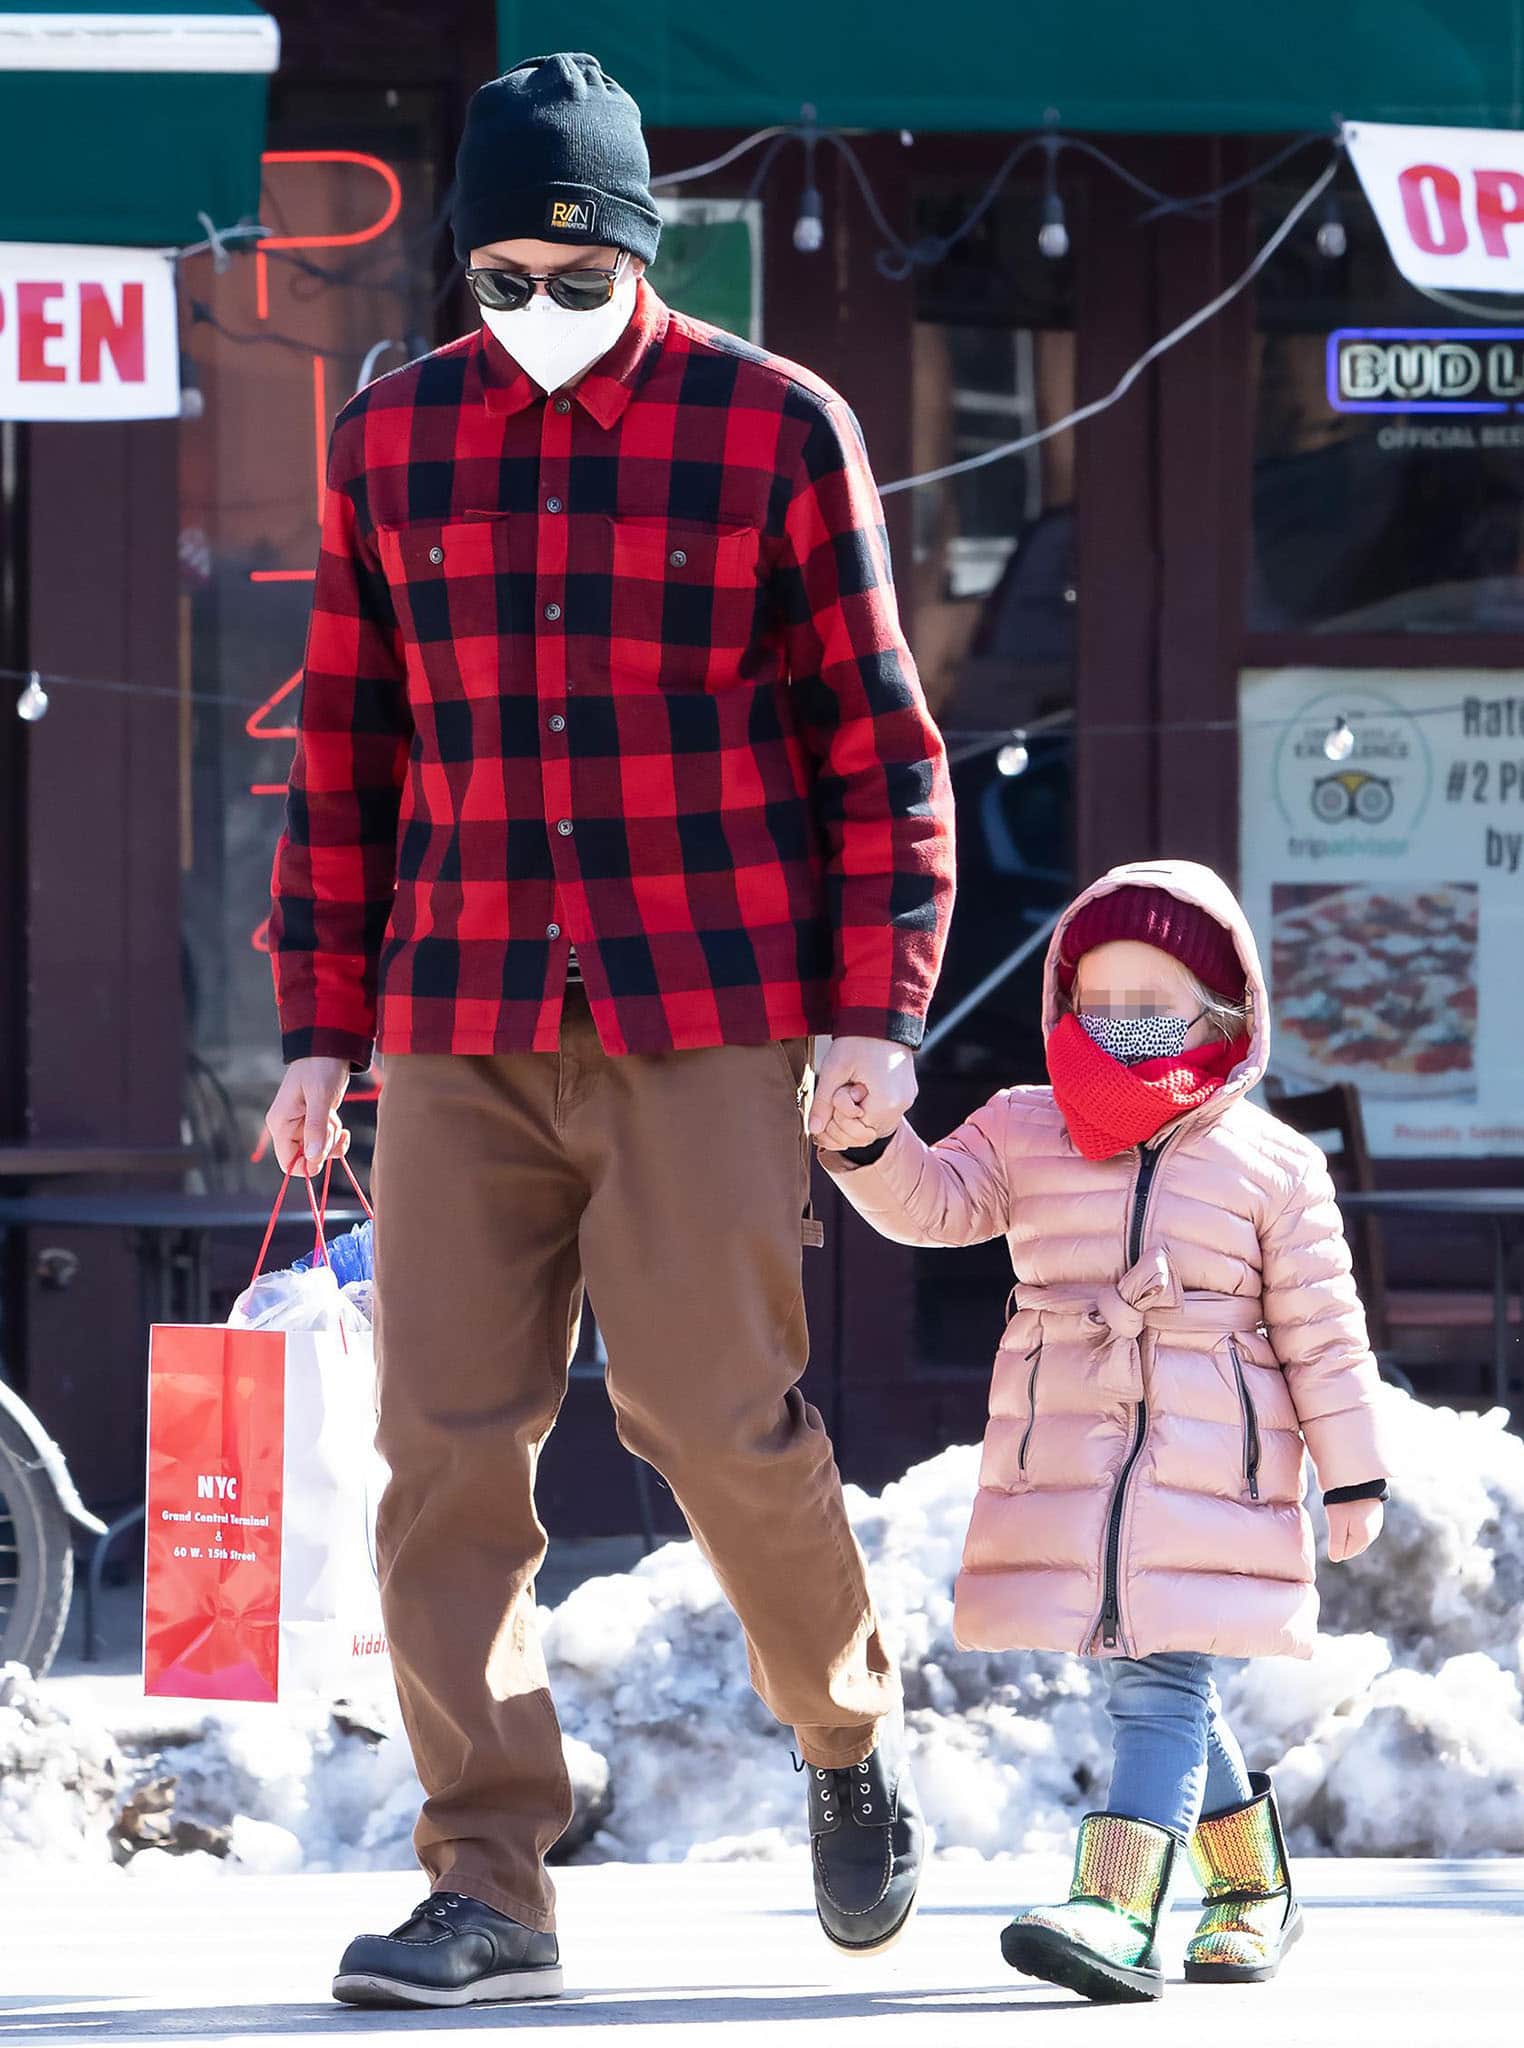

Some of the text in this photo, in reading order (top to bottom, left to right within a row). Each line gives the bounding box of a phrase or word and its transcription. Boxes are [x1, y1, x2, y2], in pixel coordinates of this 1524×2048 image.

[0, 281, 145, 383] EN
[1340, 344, 1481, 399] BUD
[1486, 819, 1523, 875] by
[197, 1475, 237, 1500] NYC
[161, 1510, 269, 1527] Grand Central Terminal
[215, 1530, 223, 1542] &
[173, 1546, 256, 1562] 60 W. 15th Street
